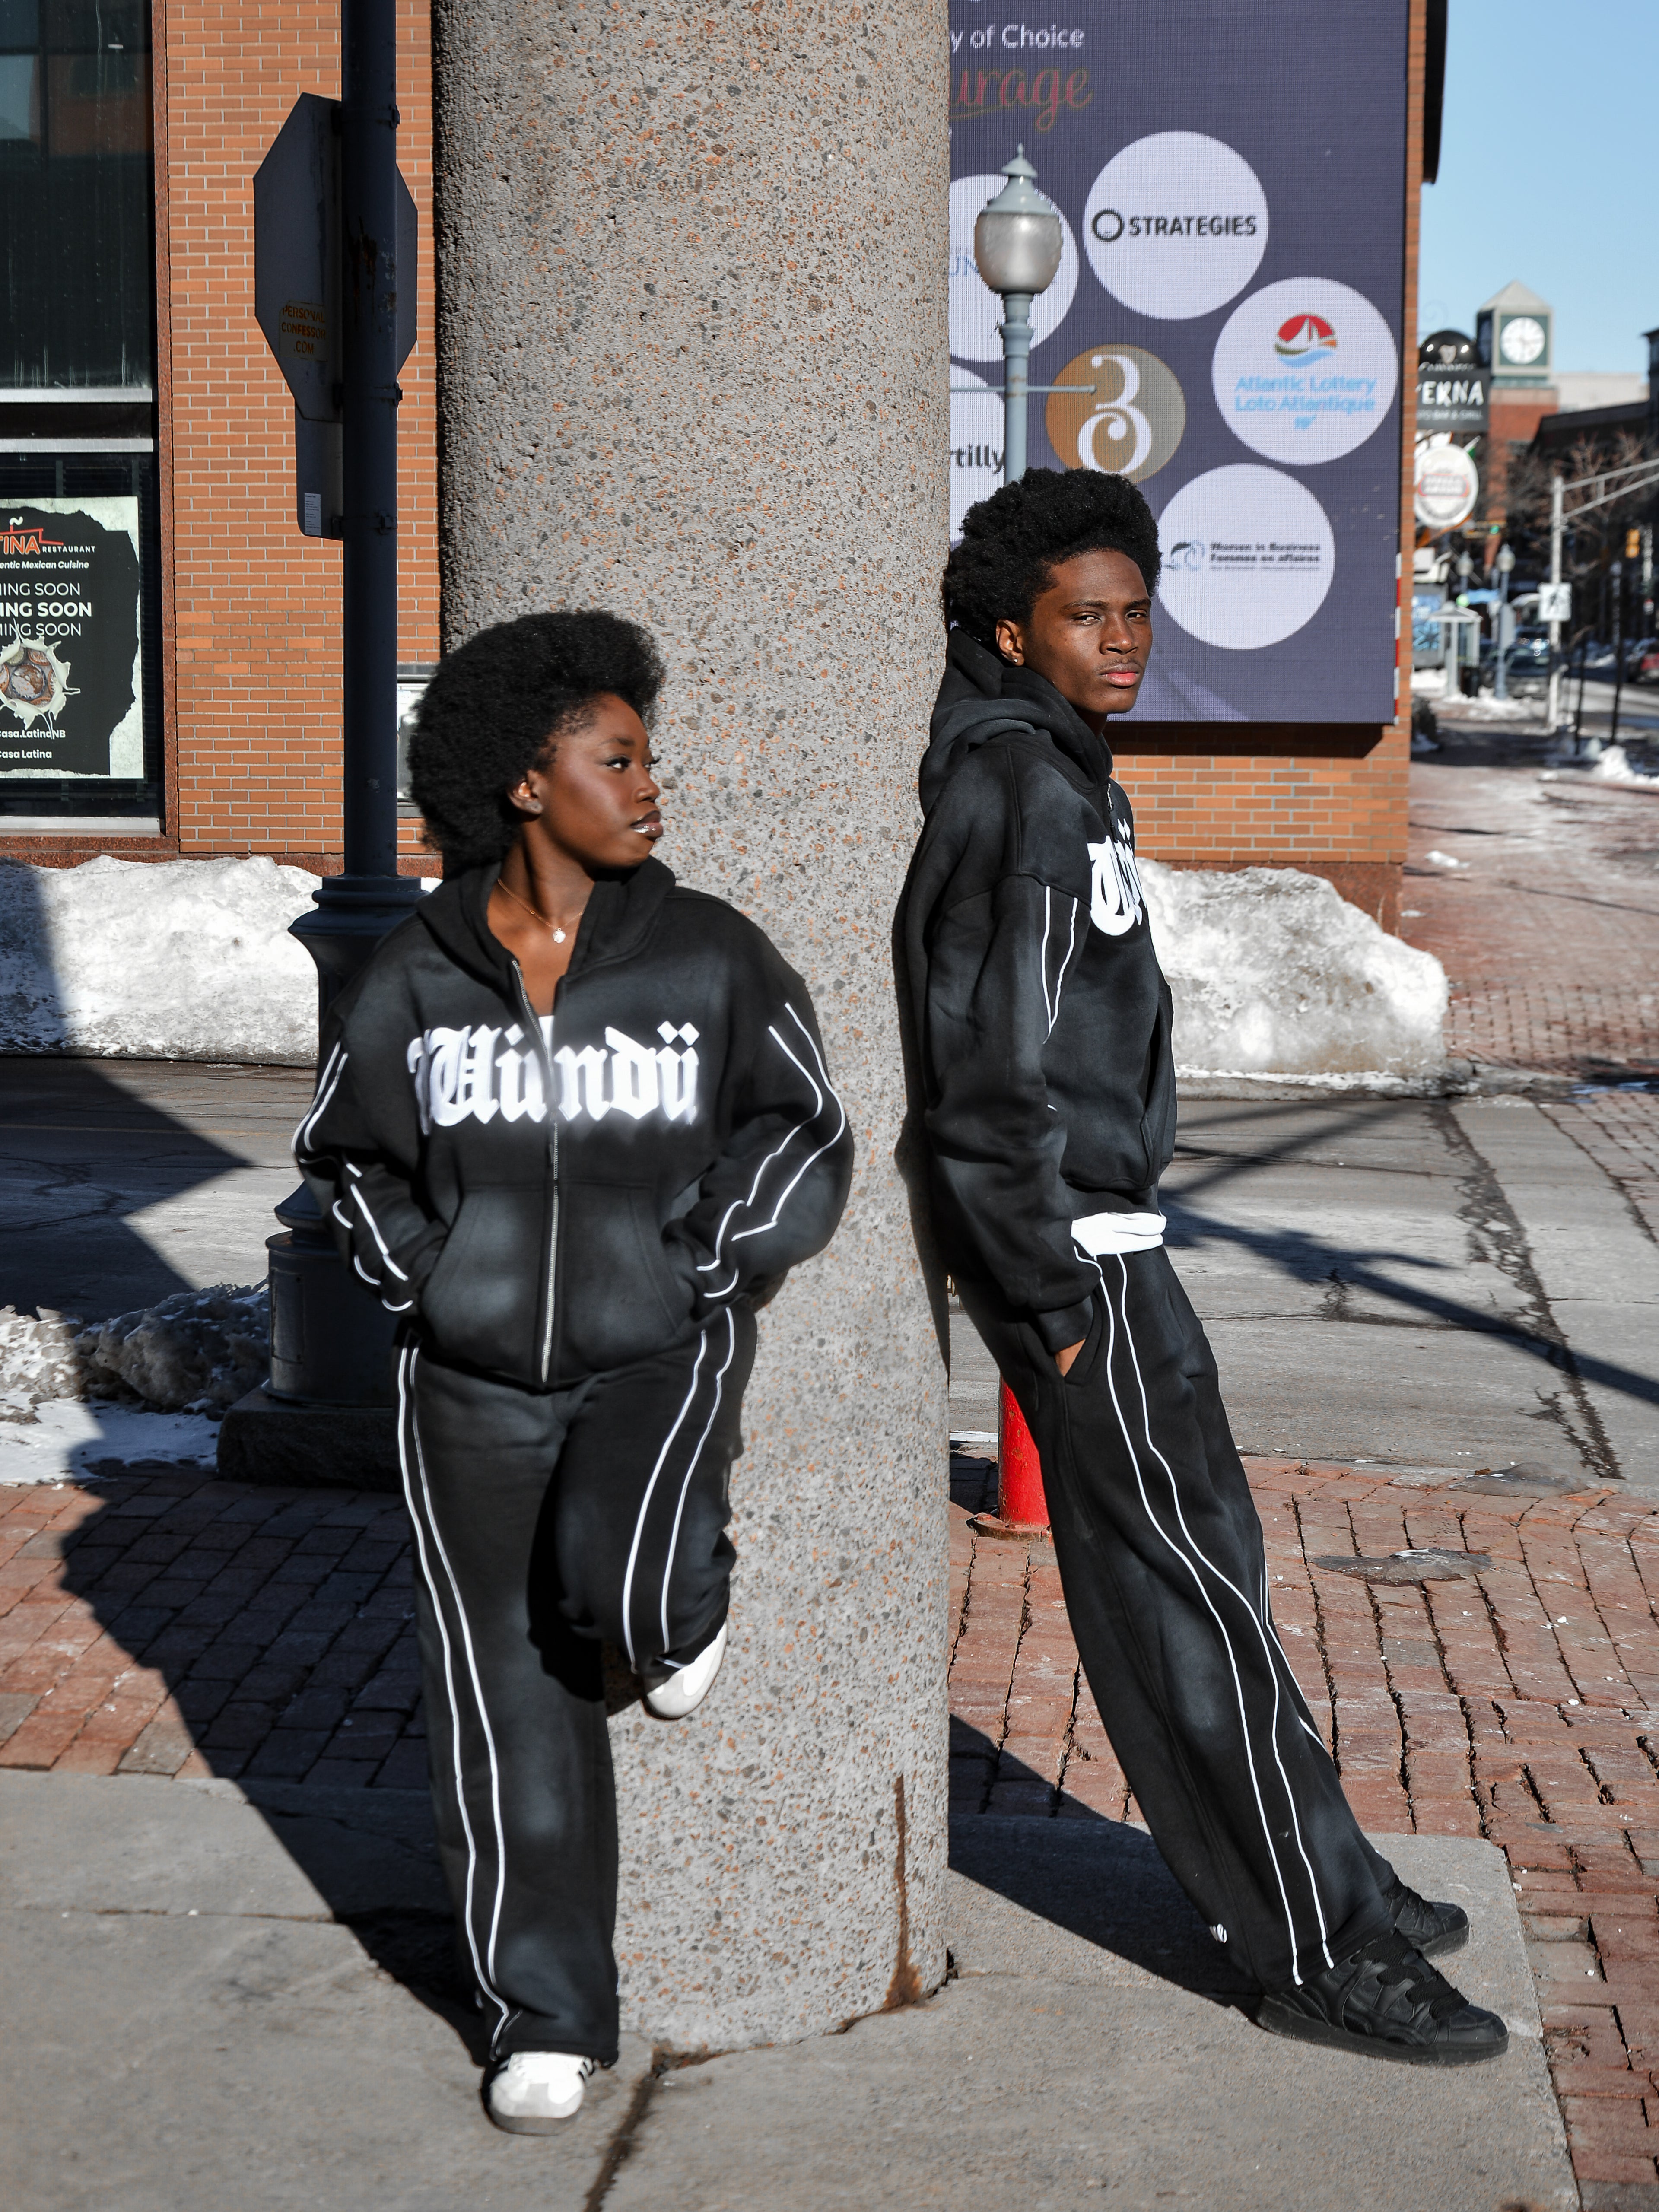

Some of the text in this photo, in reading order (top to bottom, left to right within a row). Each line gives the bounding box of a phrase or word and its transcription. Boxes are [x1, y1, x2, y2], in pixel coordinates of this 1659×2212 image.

[970, 25, 995, 48] of
[1002, 23, 1084, 48] Choice
[1130, 216, 1257, 236] STRATEGIES
[282, 305, 325, 324] PERSONAL
[281, 321, 326, 340] CONFESSOR
[293, 340, 315, 354] .COM
[1234, 375, 1377, 395] Atlantic Lottery
[1234, 395, 1376, 415] Loto Atlantique
[0, 535, 41, 555] INA
[0, 560, 89, 569] entic Mexican Cuisine
[0, 582, 81, 596] ING SOON
[37, 602, 92, 617] SOON
[0, 623, 81, 636] ING SOON
[22, 749, 52, 759] Latina
